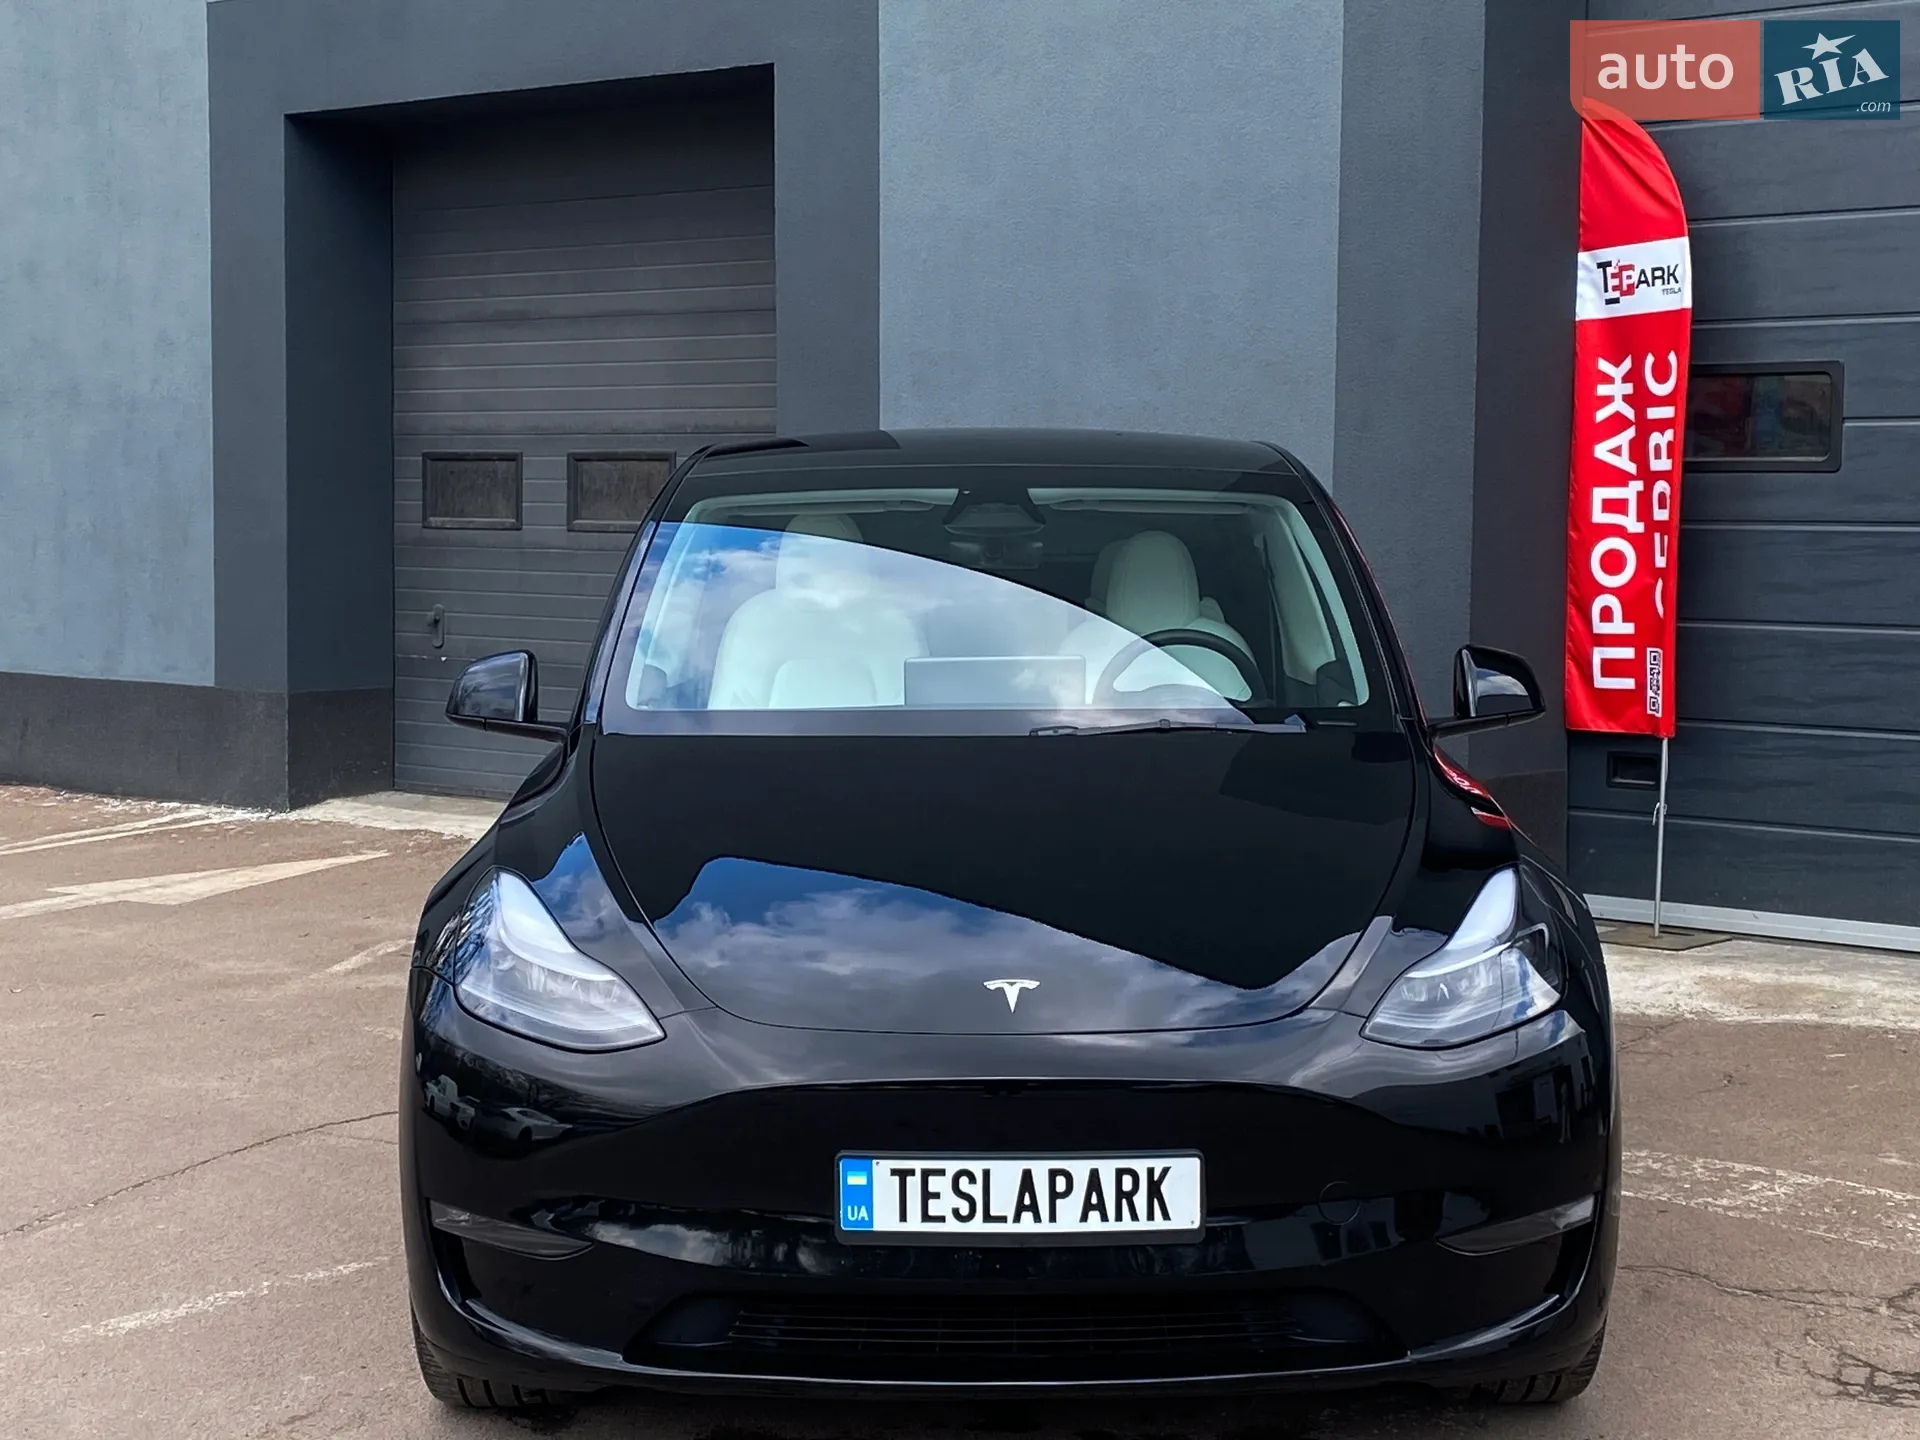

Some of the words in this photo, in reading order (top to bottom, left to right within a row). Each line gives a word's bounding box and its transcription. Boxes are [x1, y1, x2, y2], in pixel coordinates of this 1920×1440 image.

[1590, 353, 1645, 690] ПРОДАЖ
[847, 1205, 869, 1222] UA
[889, 1166, 1173, 1225] TESLAPARK
